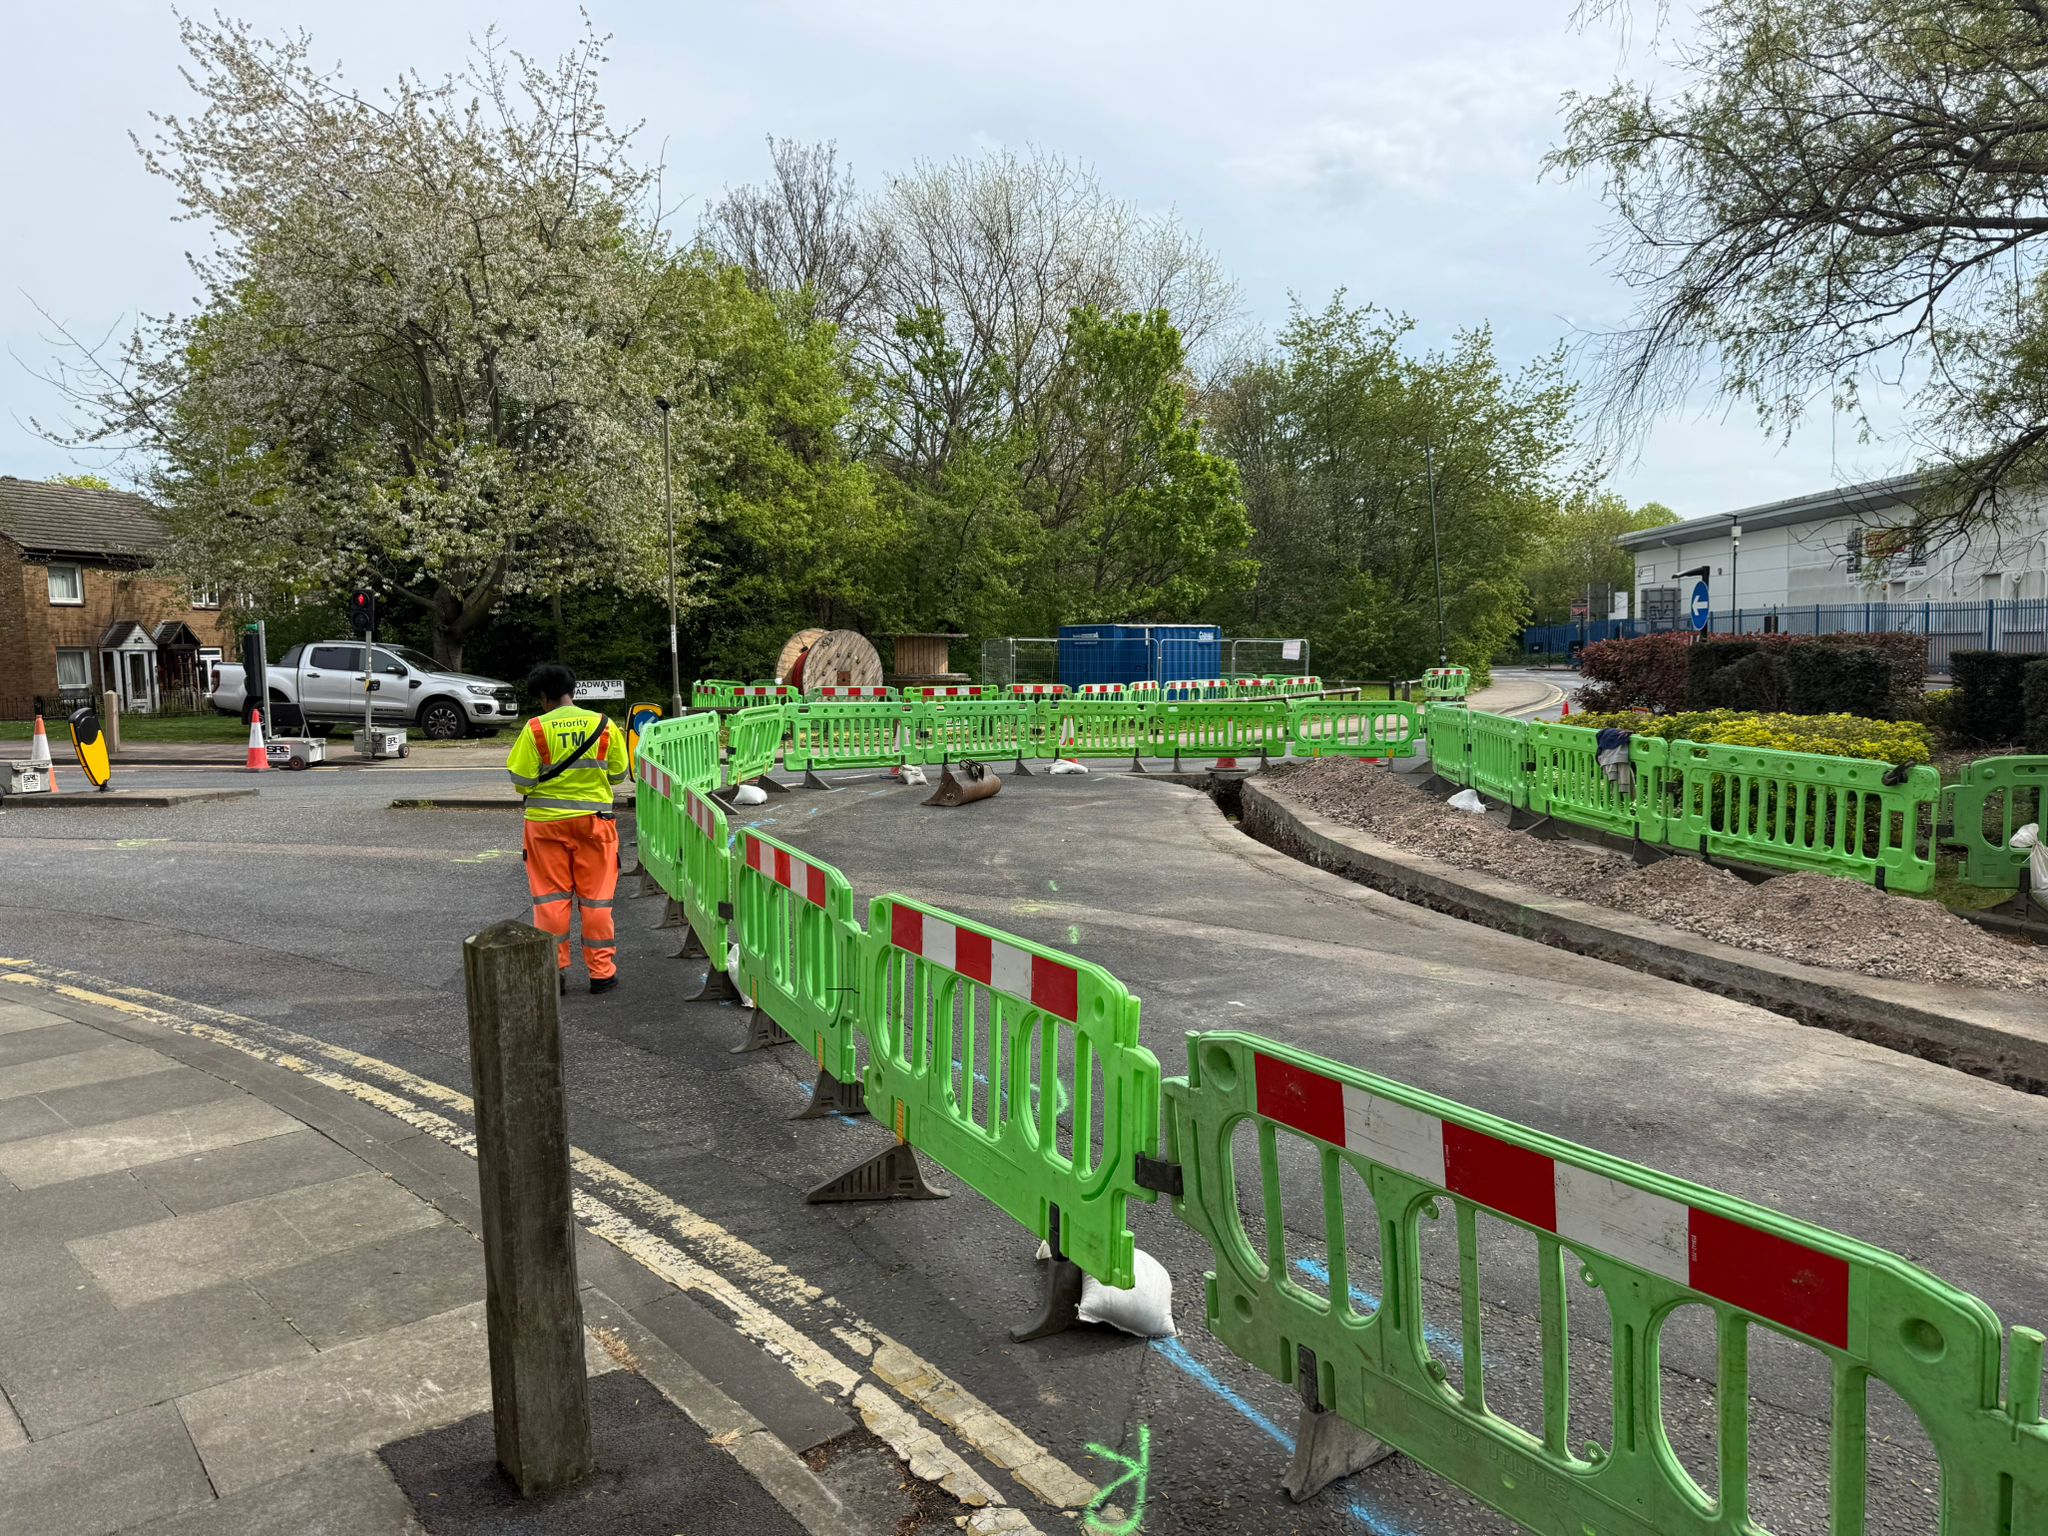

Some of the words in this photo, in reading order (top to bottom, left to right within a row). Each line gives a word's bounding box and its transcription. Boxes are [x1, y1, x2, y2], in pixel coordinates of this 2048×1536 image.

[574, 681, 622, 689] OADWATER
[551, 719, 588, 729] Priority
[557, 731, 586, 748] TM
[266, 745, 289, 753] SRL
